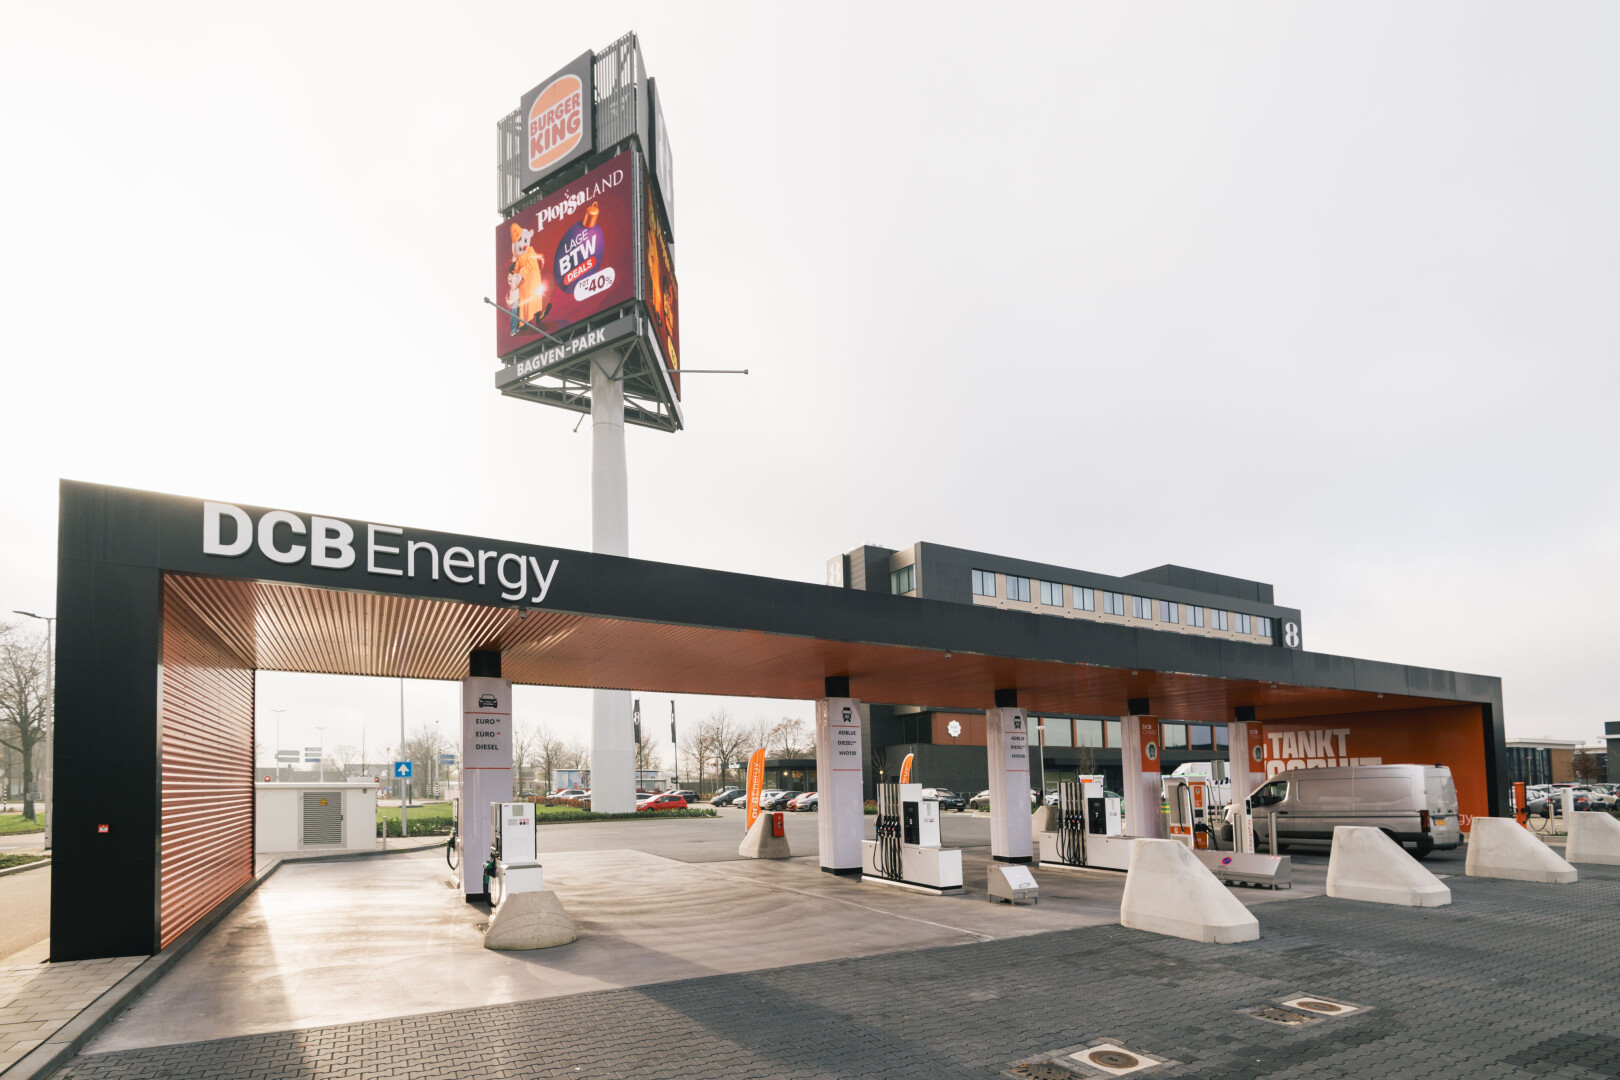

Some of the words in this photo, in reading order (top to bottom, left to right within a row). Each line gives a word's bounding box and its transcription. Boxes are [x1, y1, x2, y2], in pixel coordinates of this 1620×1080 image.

[530, 92, 580, 137] BURGER
[530, 109, 581, 159] KING
[559, 234, 597, 277] BTW
[564, 228, 589, 254] LAGE
[567, 259, 593, 283] DEALS
[579, 278, 590, 289] TOT
[516, 327, 606, 377] BAGVEN-PARK
[203, 501, 356, 570] DCB
[367, 523, 560, 604] Energy
[1285, 621, 1300, 648] 8
[1267, 728, 1351, 760] TANKT
